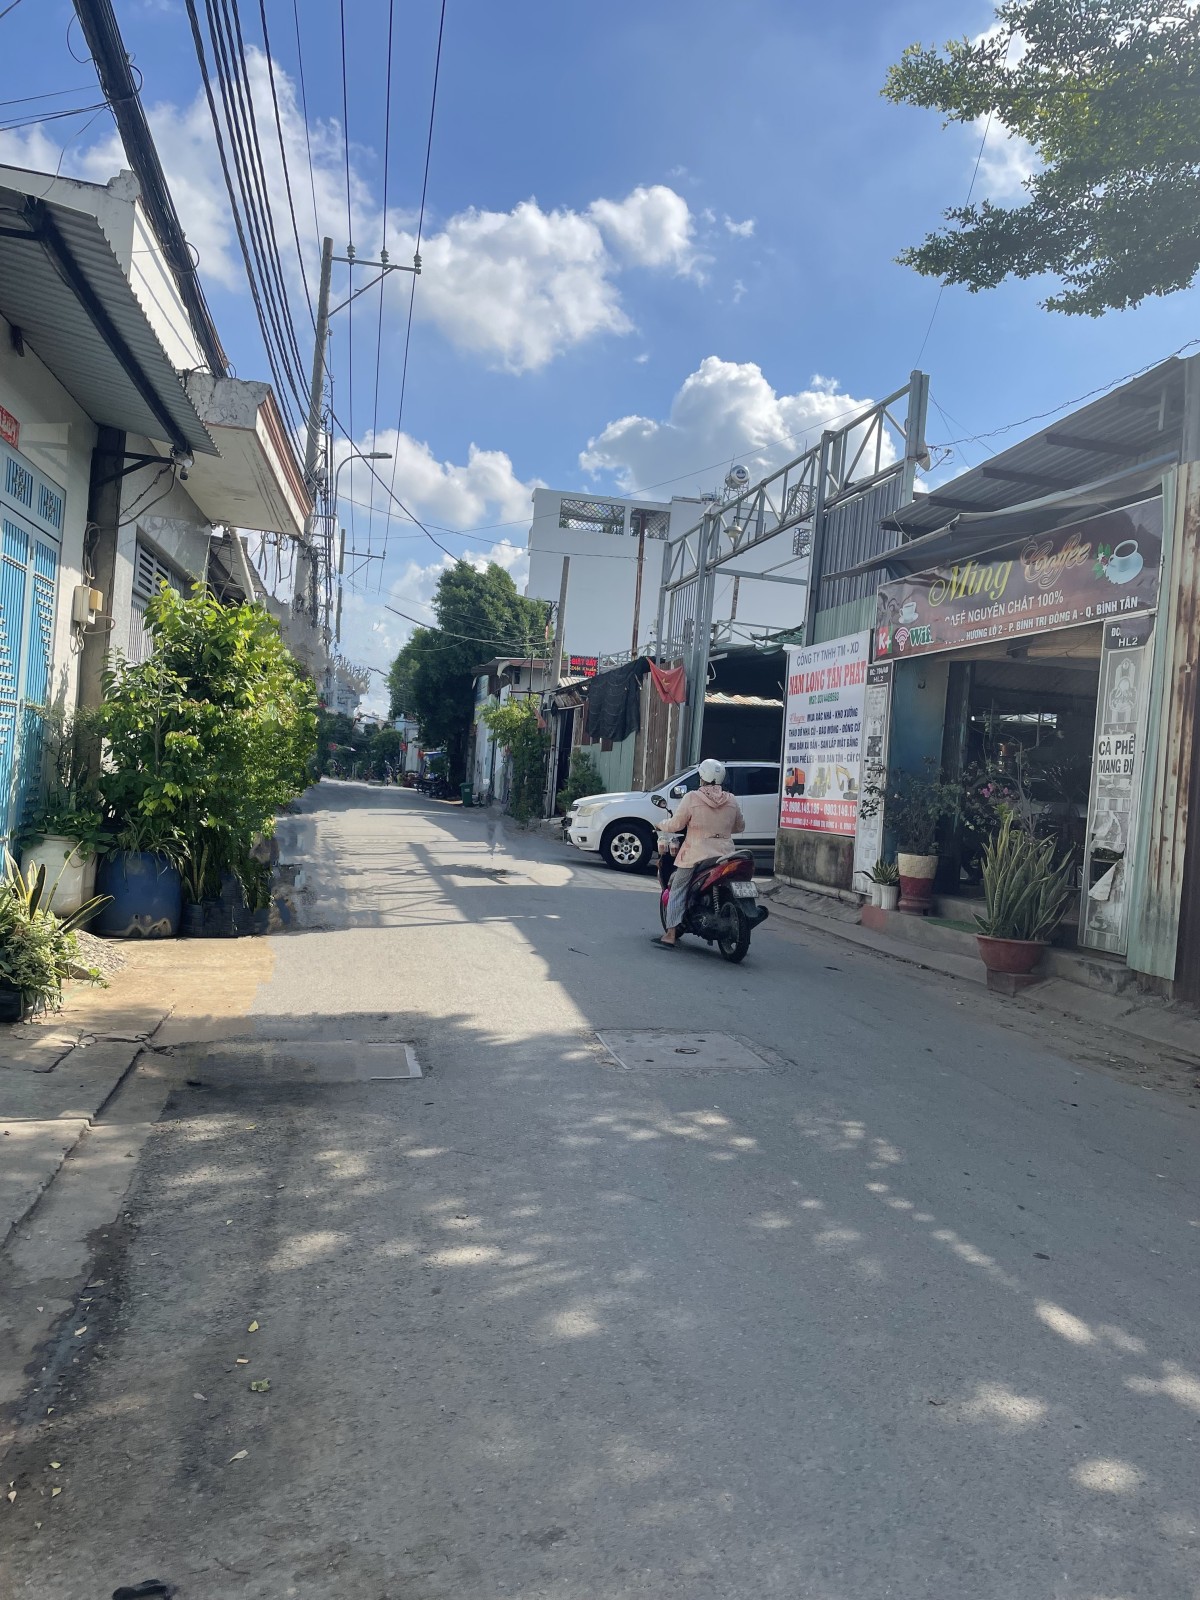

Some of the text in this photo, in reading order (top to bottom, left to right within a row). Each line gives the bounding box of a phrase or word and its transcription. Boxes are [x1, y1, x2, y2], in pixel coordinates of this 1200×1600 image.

[929, 531, 1092, 607] Ming Coffee
[1037, 589, 1064, 608] 100%
[998, 624, 1004, 634] 2
[1071, 609, 1079, 620] A
[1085, 606, 1094, 617] Q.
[1096, 600, 1118, 615] BÌNH
[1119, 596, 1138, 609] TÂN
[879, 632, 891, 650] K+
[1118, 637, 1138, 647] HL2
[796, 652, 812, 667] CÔNG
[813, 651, 820, 663] TY
[850, 641, 860, 655] XD
[789, 673, 805, 696] NAM
[1098, 733, 1136, 756] CÀ PHÊ
[1099, 759, 1121, 773] MANG
